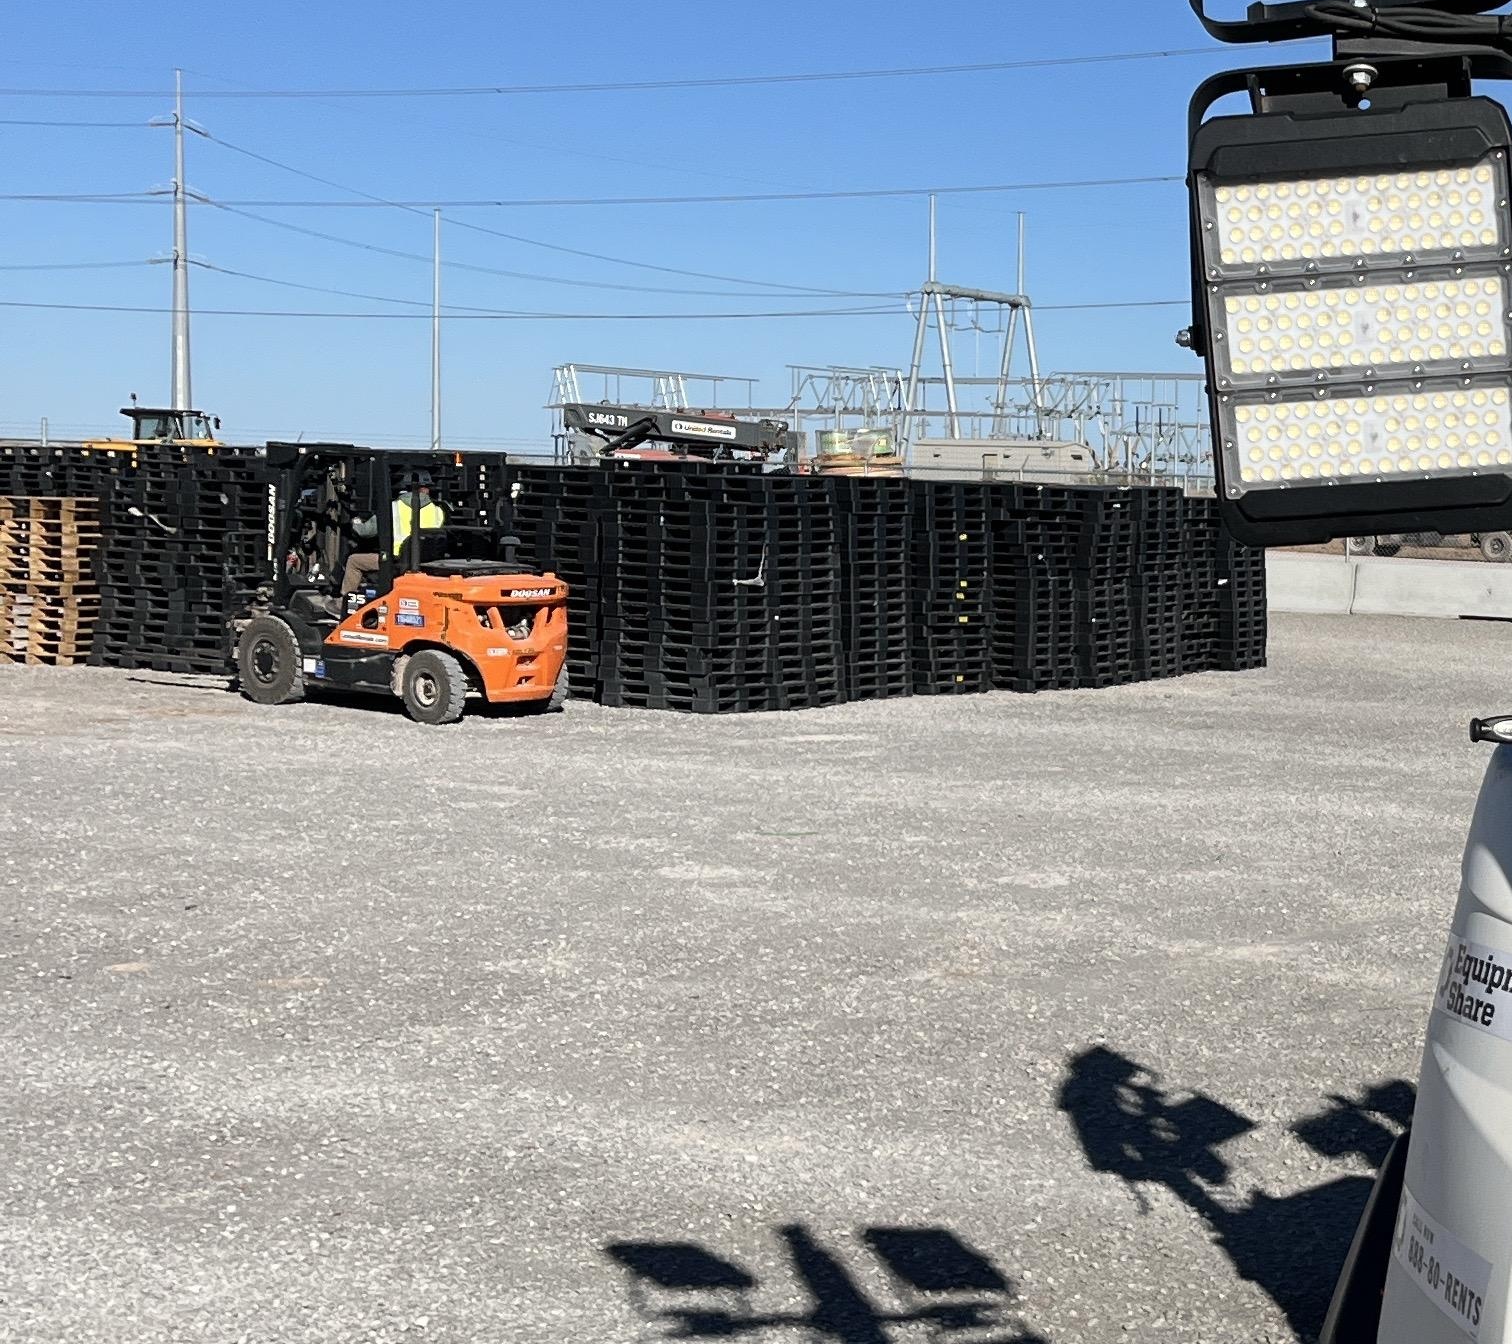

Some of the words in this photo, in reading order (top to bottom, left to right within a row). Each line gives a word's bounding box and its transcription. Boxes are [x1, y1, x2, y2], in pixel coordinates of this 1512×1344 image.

[267, 483, 276, 544] DOOSAN
[347, 593, 366, 604] 35
[511, 588, 551, 598] DOOSAN
[1446, 980, 1496, 1027] Share
[1407, 1234, 1482, 1326] 888-80-RENTS
